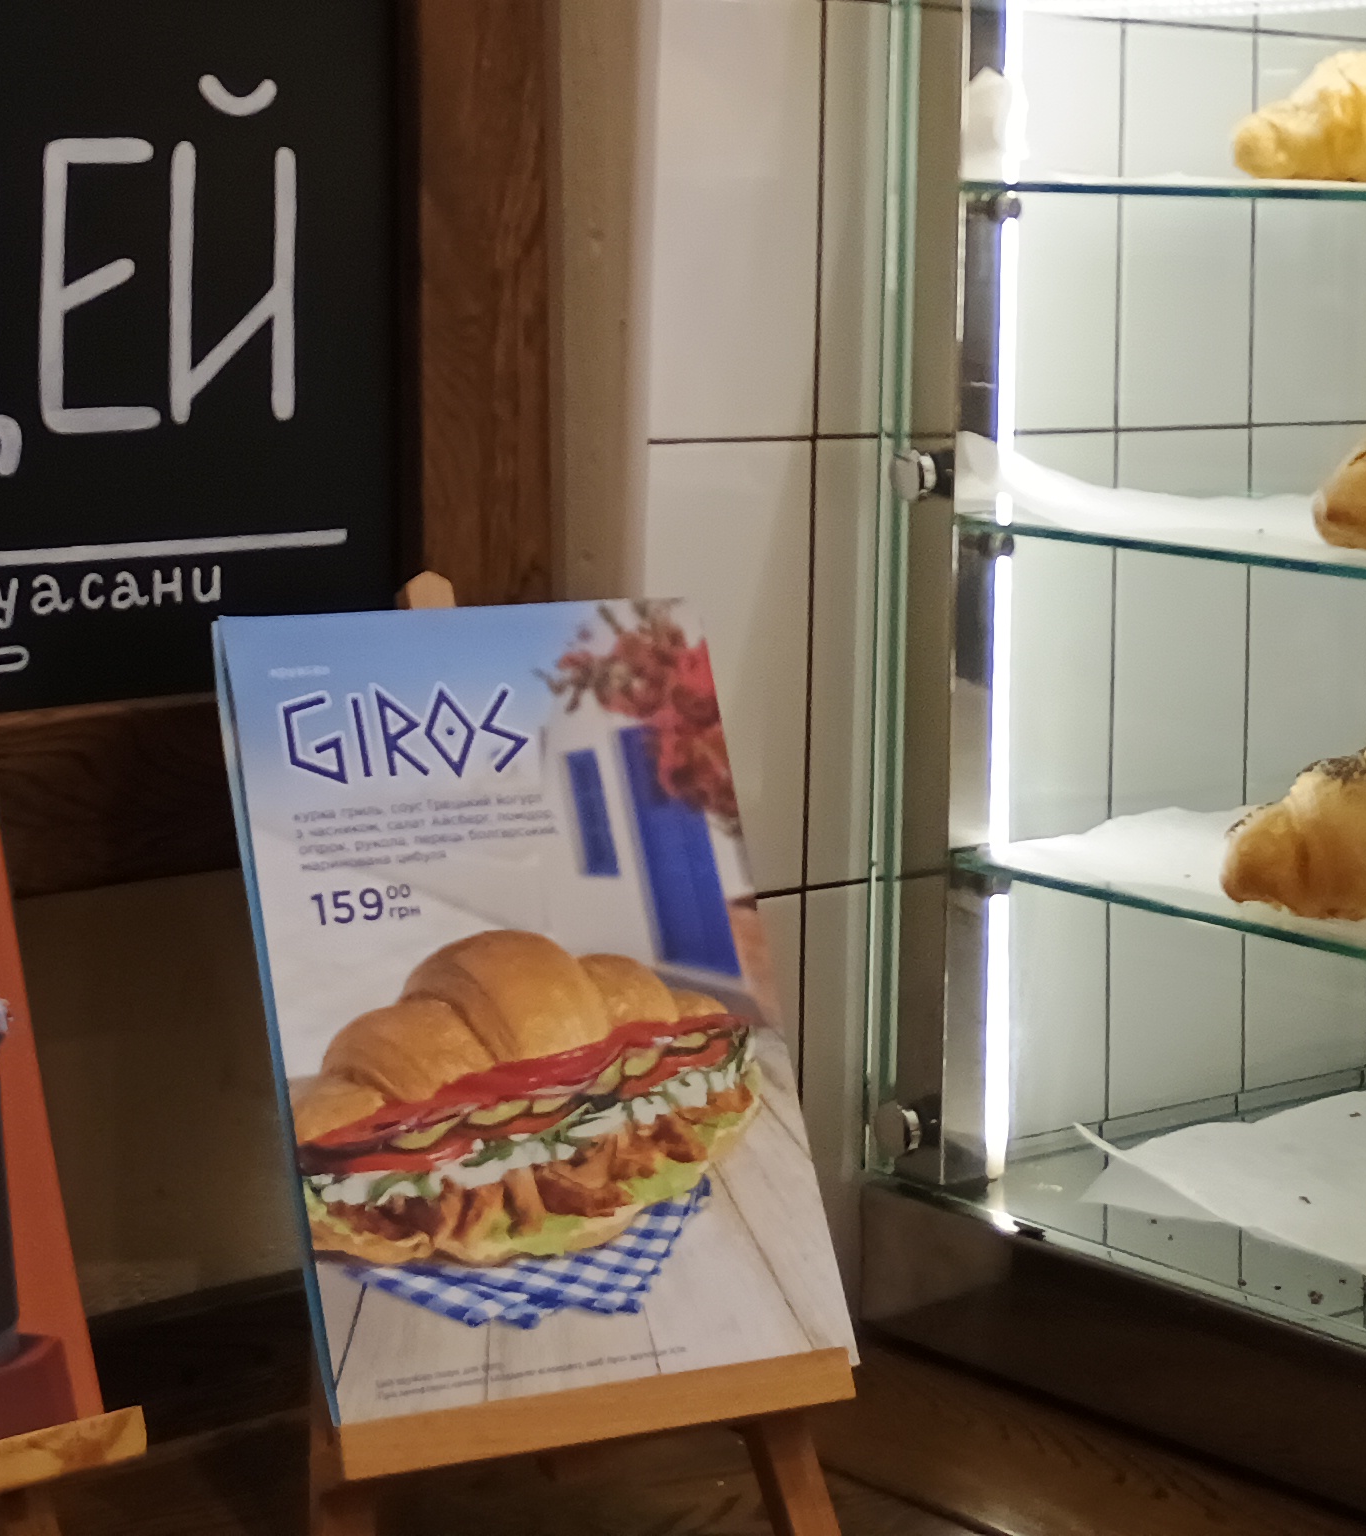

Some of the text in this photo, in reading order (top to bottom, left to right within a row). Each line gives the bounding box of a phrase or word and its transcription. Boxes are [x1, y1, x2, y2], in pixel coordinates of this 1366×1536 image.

[280, 687, 530, 785] GIROS
[311, 883, 411, 926] 159 00
[389, 906, 421, 920] грн
